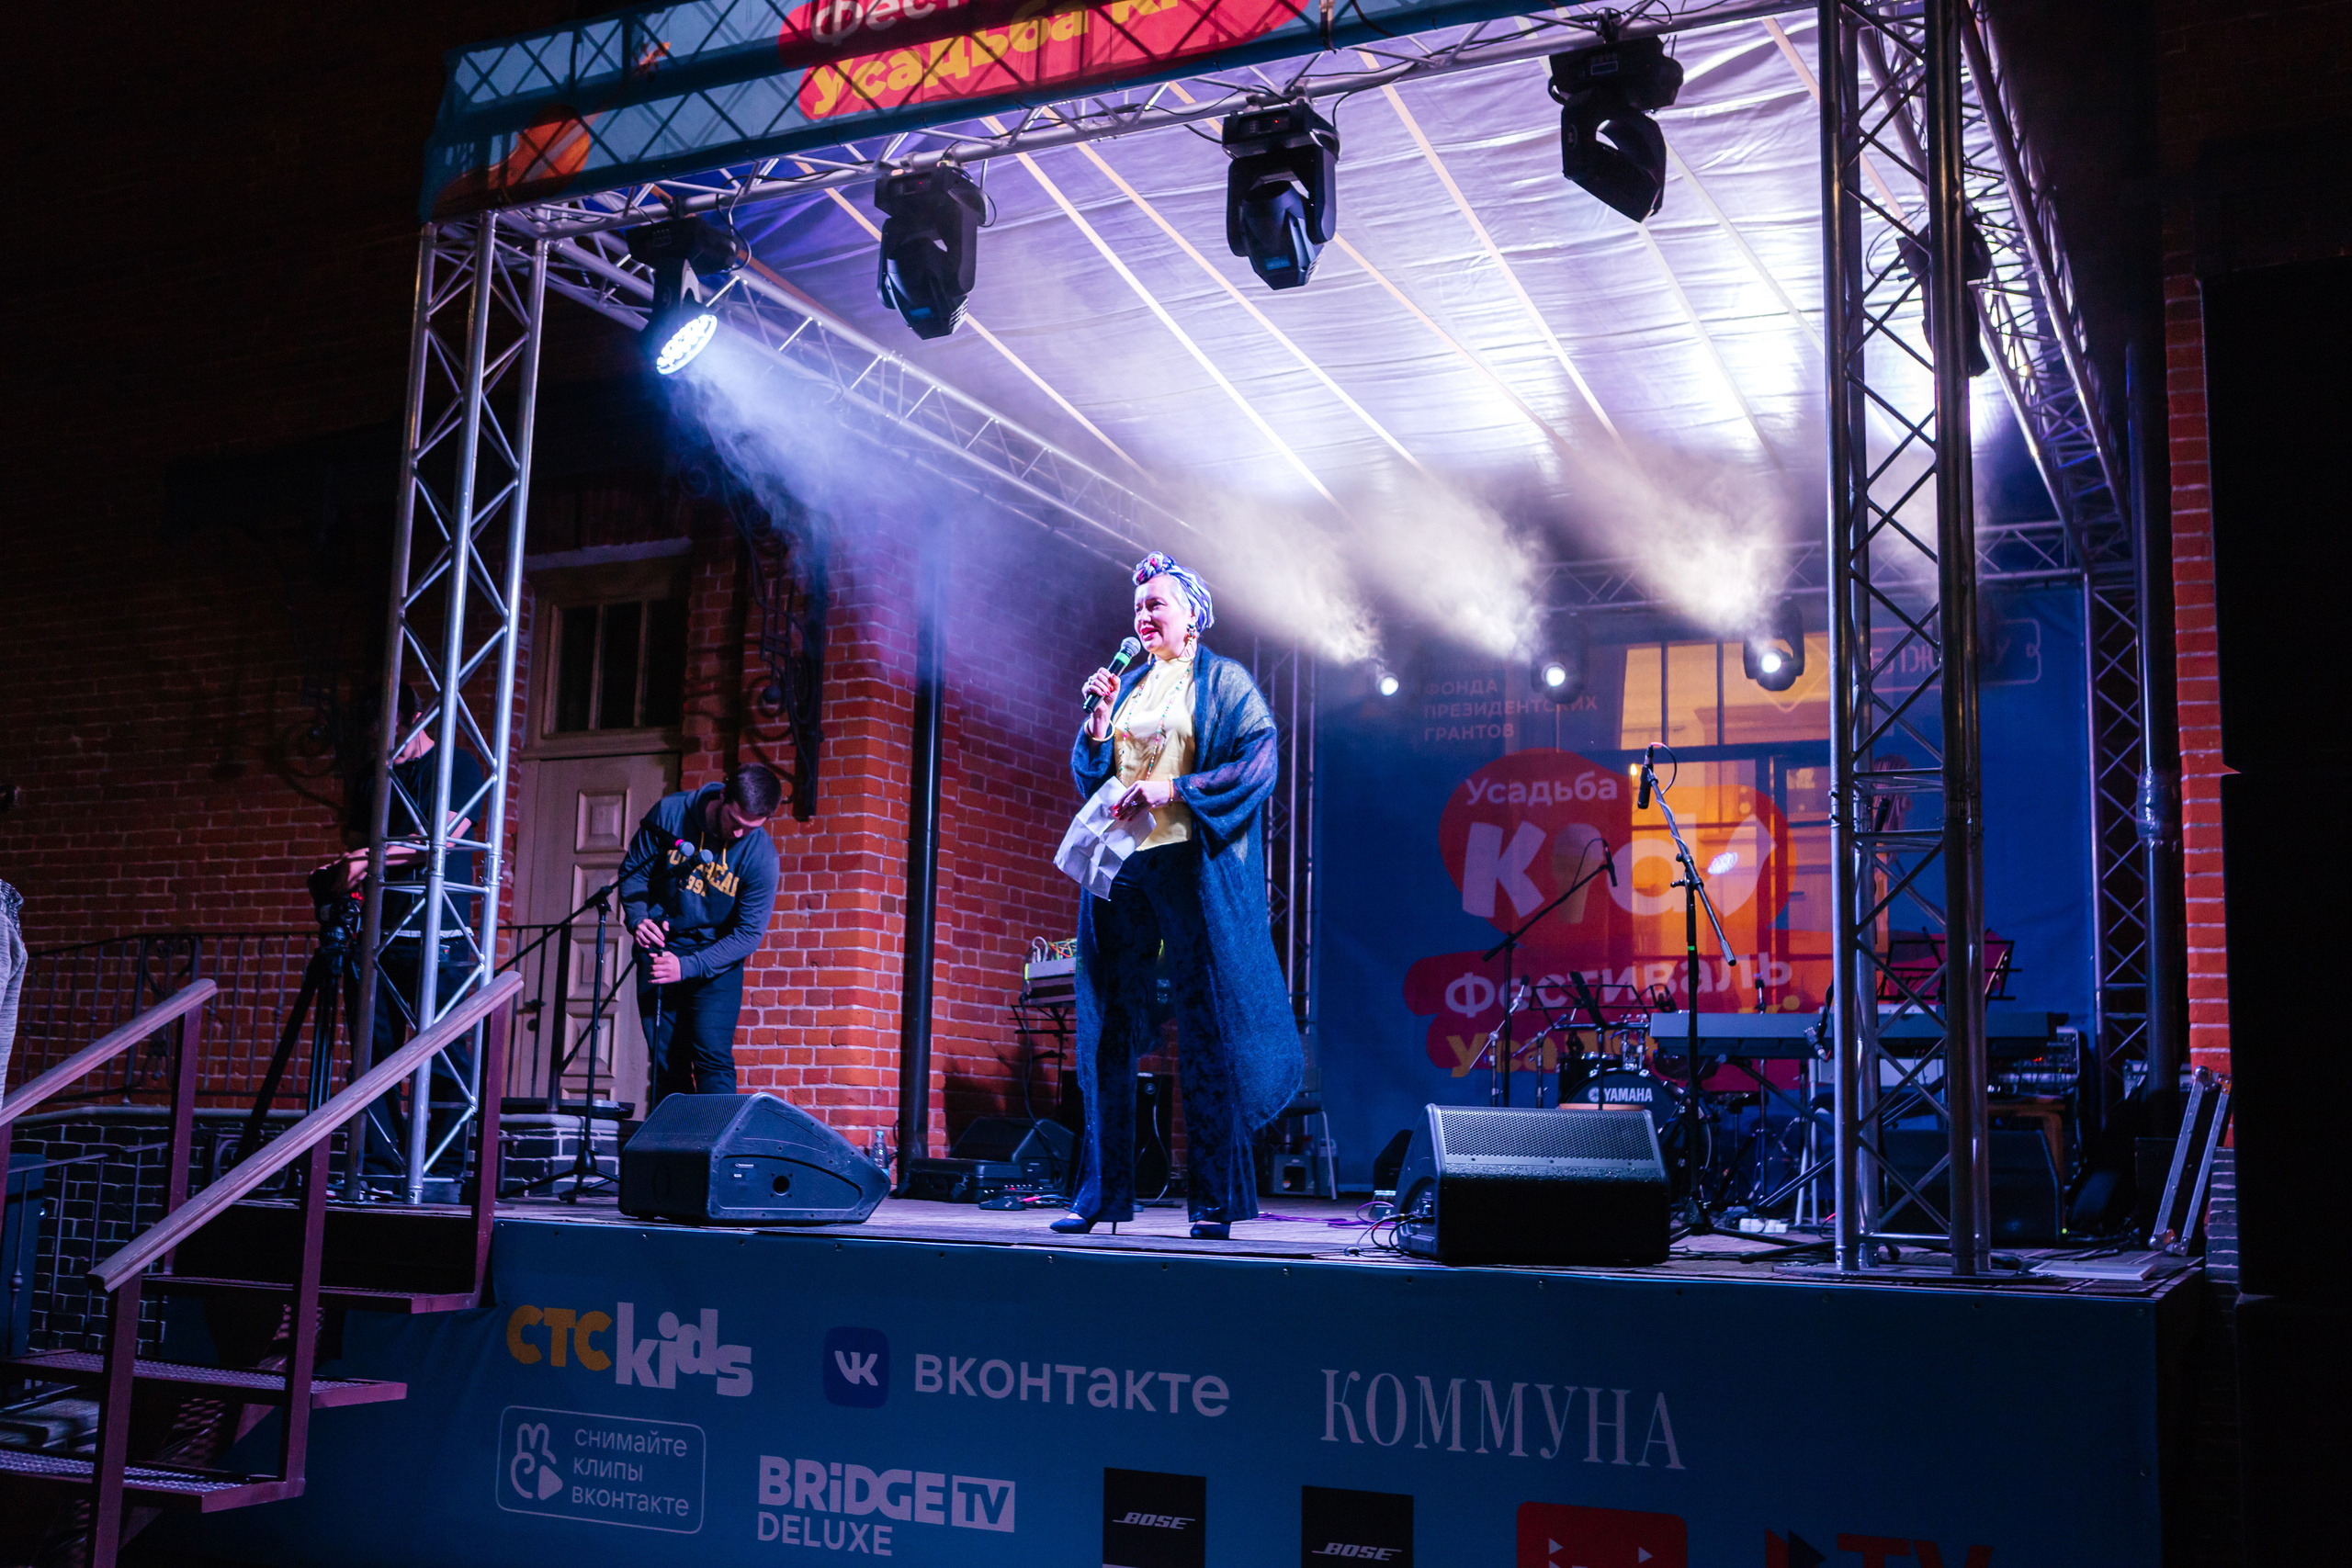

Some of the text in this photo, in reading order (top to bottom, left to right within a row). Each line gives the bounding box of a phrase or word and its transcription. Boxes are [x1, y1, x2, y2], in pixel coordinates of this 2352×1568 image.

[811, 0, 959, 46] Фес
[1426, 679, 1498, 697] ФОНДА
[1425, 722, 1515, 742] ГРАНТОВ
[1464, 771, 1618, 807] Усадьба
[1603, 1087, 1654, 1102] YAMAHA
[615, 1301, 753, 1397] kids
[1320, 1369, 1686, 1470] КОММУНА
[574, 1428, 688, 1458] снимайте
[573, 1457, 643, 1483] клипы
[571, 1485, 689, 1517] вконтакте
[954, 1478, 1013, 1529] TV
[757, 1511, 893, 1557] DELUXE
[1113, 1511, 1196, 1530] BOSE
[1311, 1541, 1402, 1561] BOSE
